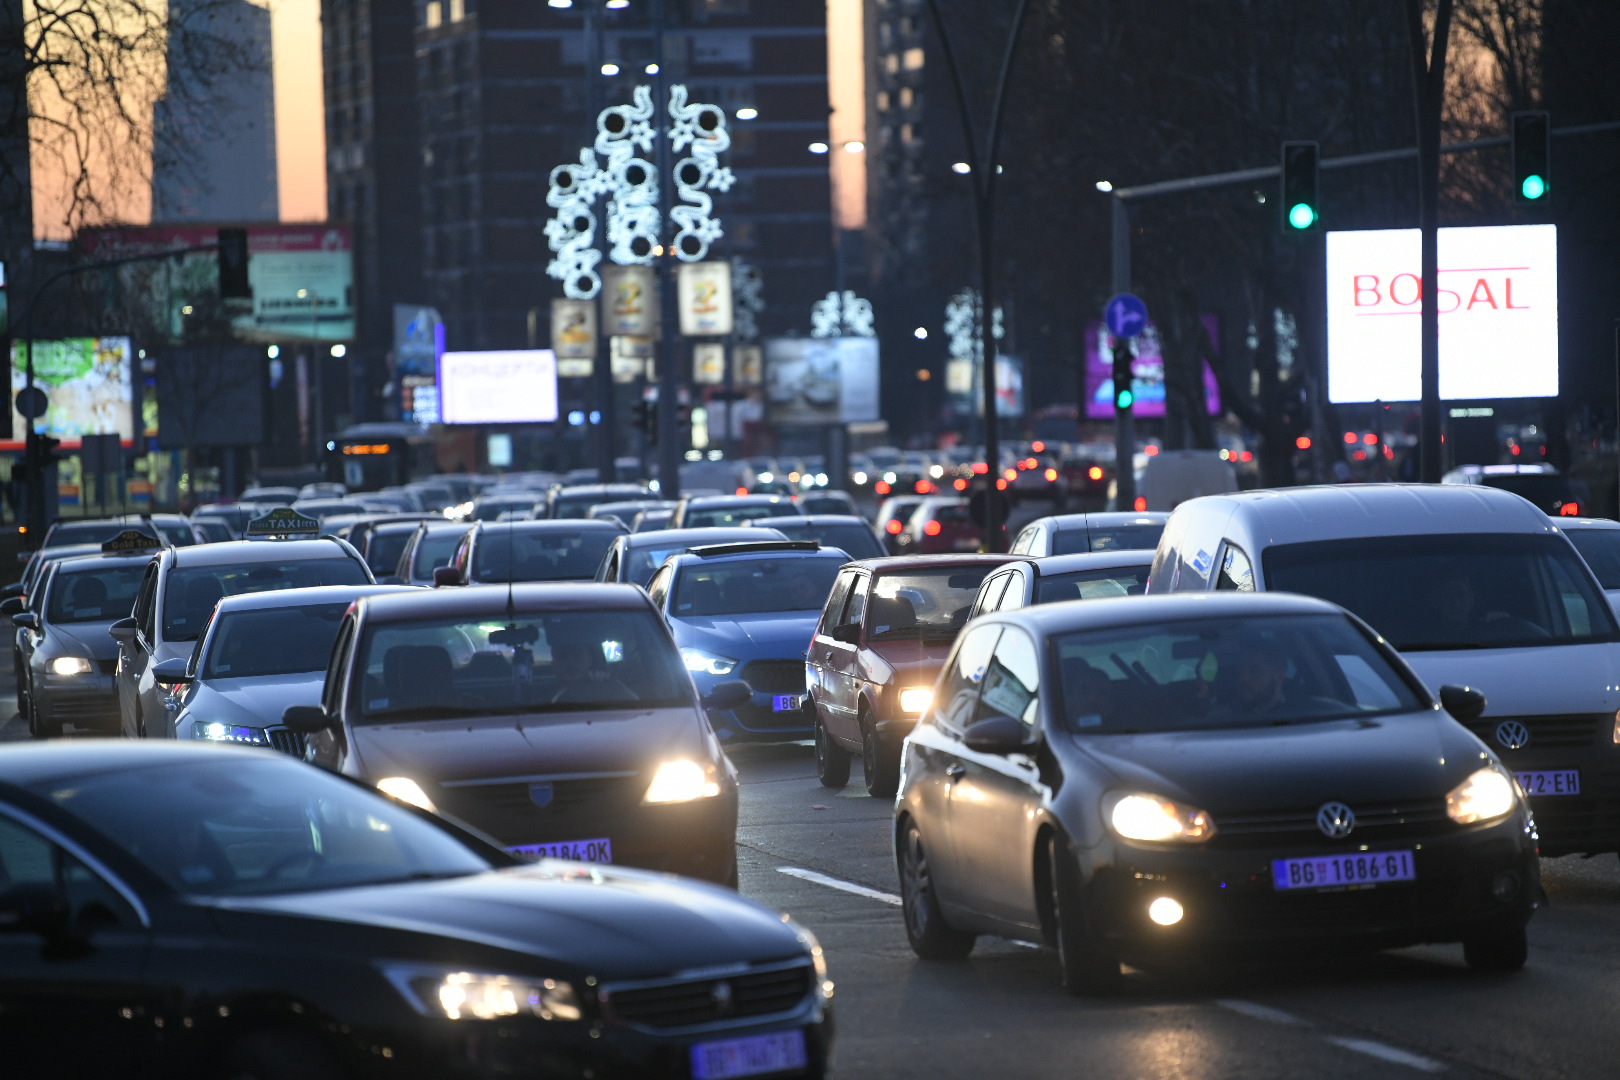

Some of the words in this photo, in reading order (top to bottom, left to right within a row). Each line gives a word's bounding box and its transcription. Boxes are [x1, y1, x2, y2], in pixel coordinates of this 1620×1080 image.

[268, 519, 301, 529] TAXI
[111, 539, 135, 550] Gold
[137, 538, 157, 548] Taxi
[782, 696, 796, 710] BG
[1288, 861, 1315, 885] BG
